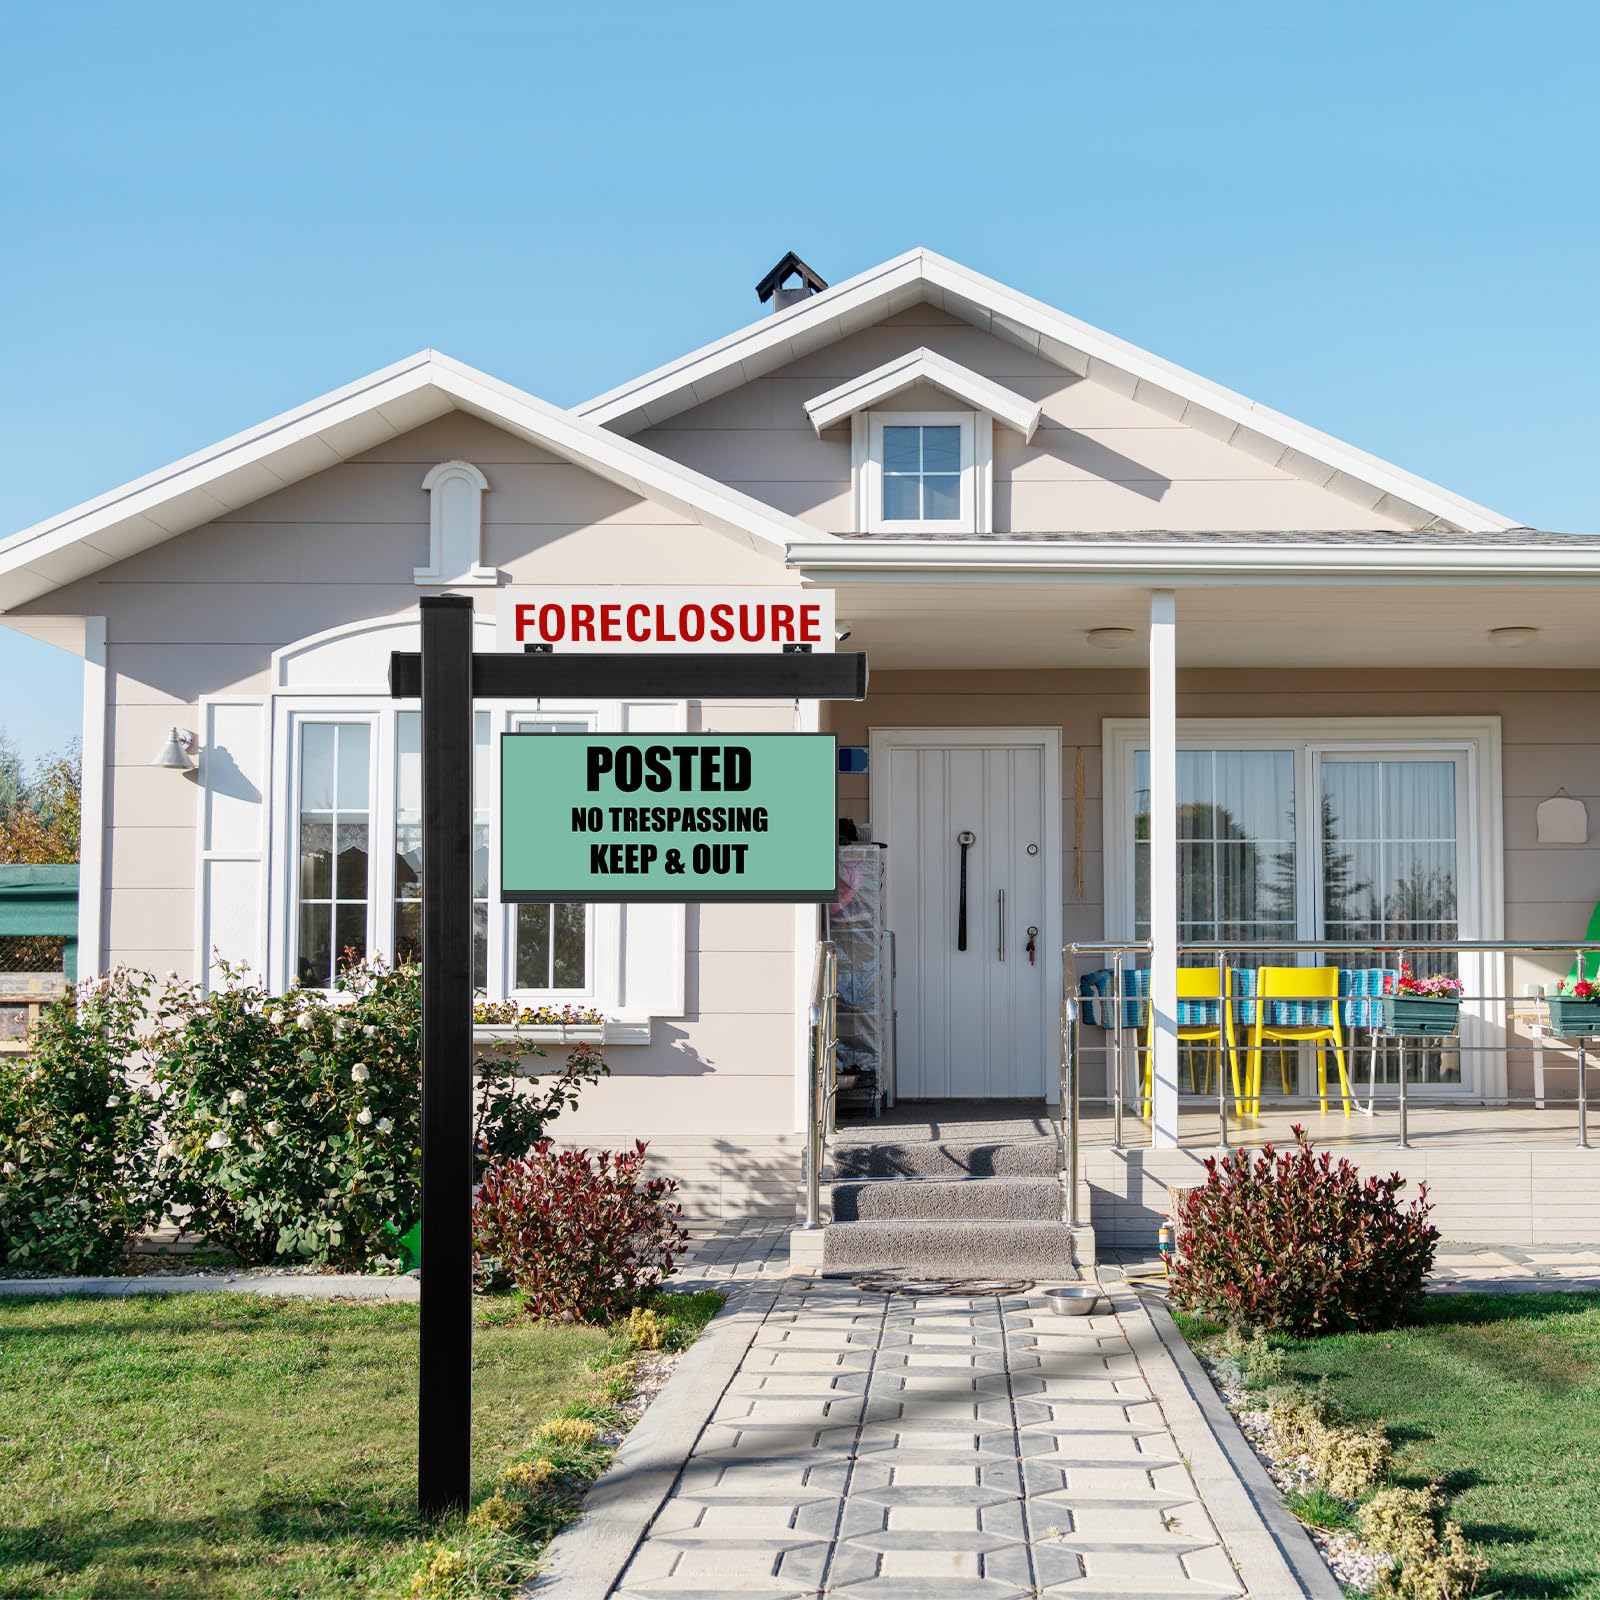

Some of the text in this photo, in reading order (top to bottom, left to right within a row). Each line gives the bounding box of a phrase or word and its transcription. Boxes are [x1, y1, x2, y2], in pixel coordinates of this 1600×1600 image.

[516, 604, 821, 642] FORECLOSURE
[587, 746, 751, 792] POSTED
[572, 807, 768, 832] NO TRESPASSING
[591, 844, 748, 874] KEEP & OUT
